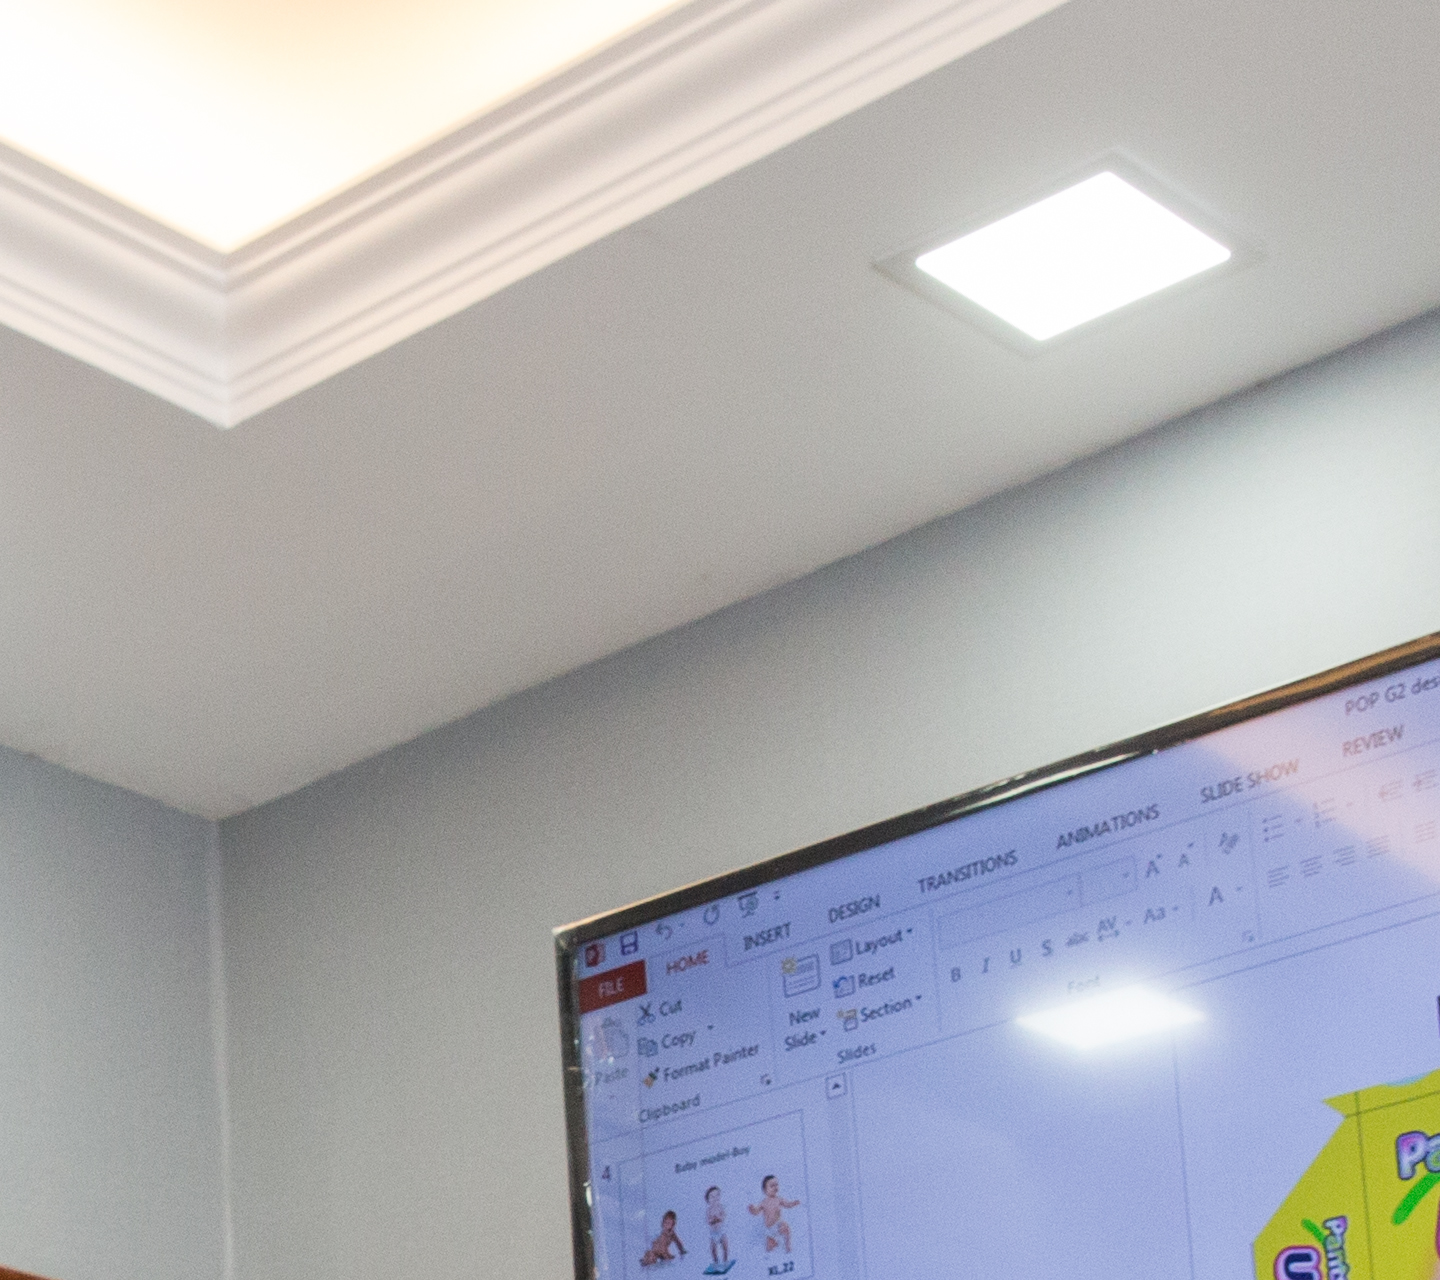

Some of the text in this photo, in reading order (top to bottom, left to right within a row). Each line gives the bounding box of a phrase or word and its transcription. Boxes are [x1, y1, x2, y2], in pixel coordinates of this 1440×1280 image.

[1341, 723, 1405, 759] REVIEW
[1199, 758, 1300, 805] SLIDE SHOW
[1055, 802, 1161, 851] ANIMATIONS
[917, 848, 1019, 894] TRANSITIONS
[828, 894, 882, 924] DESIGN
[742, 921, 793, 951] INSERT
[854, 928, 905, 957] Layout
[665, 948, 711, 976] HOME
[597, 977, 626, 999] FILE
[857, 965, 897, 990] Reset
[658, 999, 683, 1019] Cut
[788, 1007, 821, 1027] New
[859, 995, 914, 1024] Section
[660, 1029, 697, 1051] Copy
[784, 1029, 818, 1052] Slide
[836, 1040, 878, 1066] Slides
[662, 1042, 761, 1083] Format Painter
[638, 1094, 701, 1124] Clipboard
